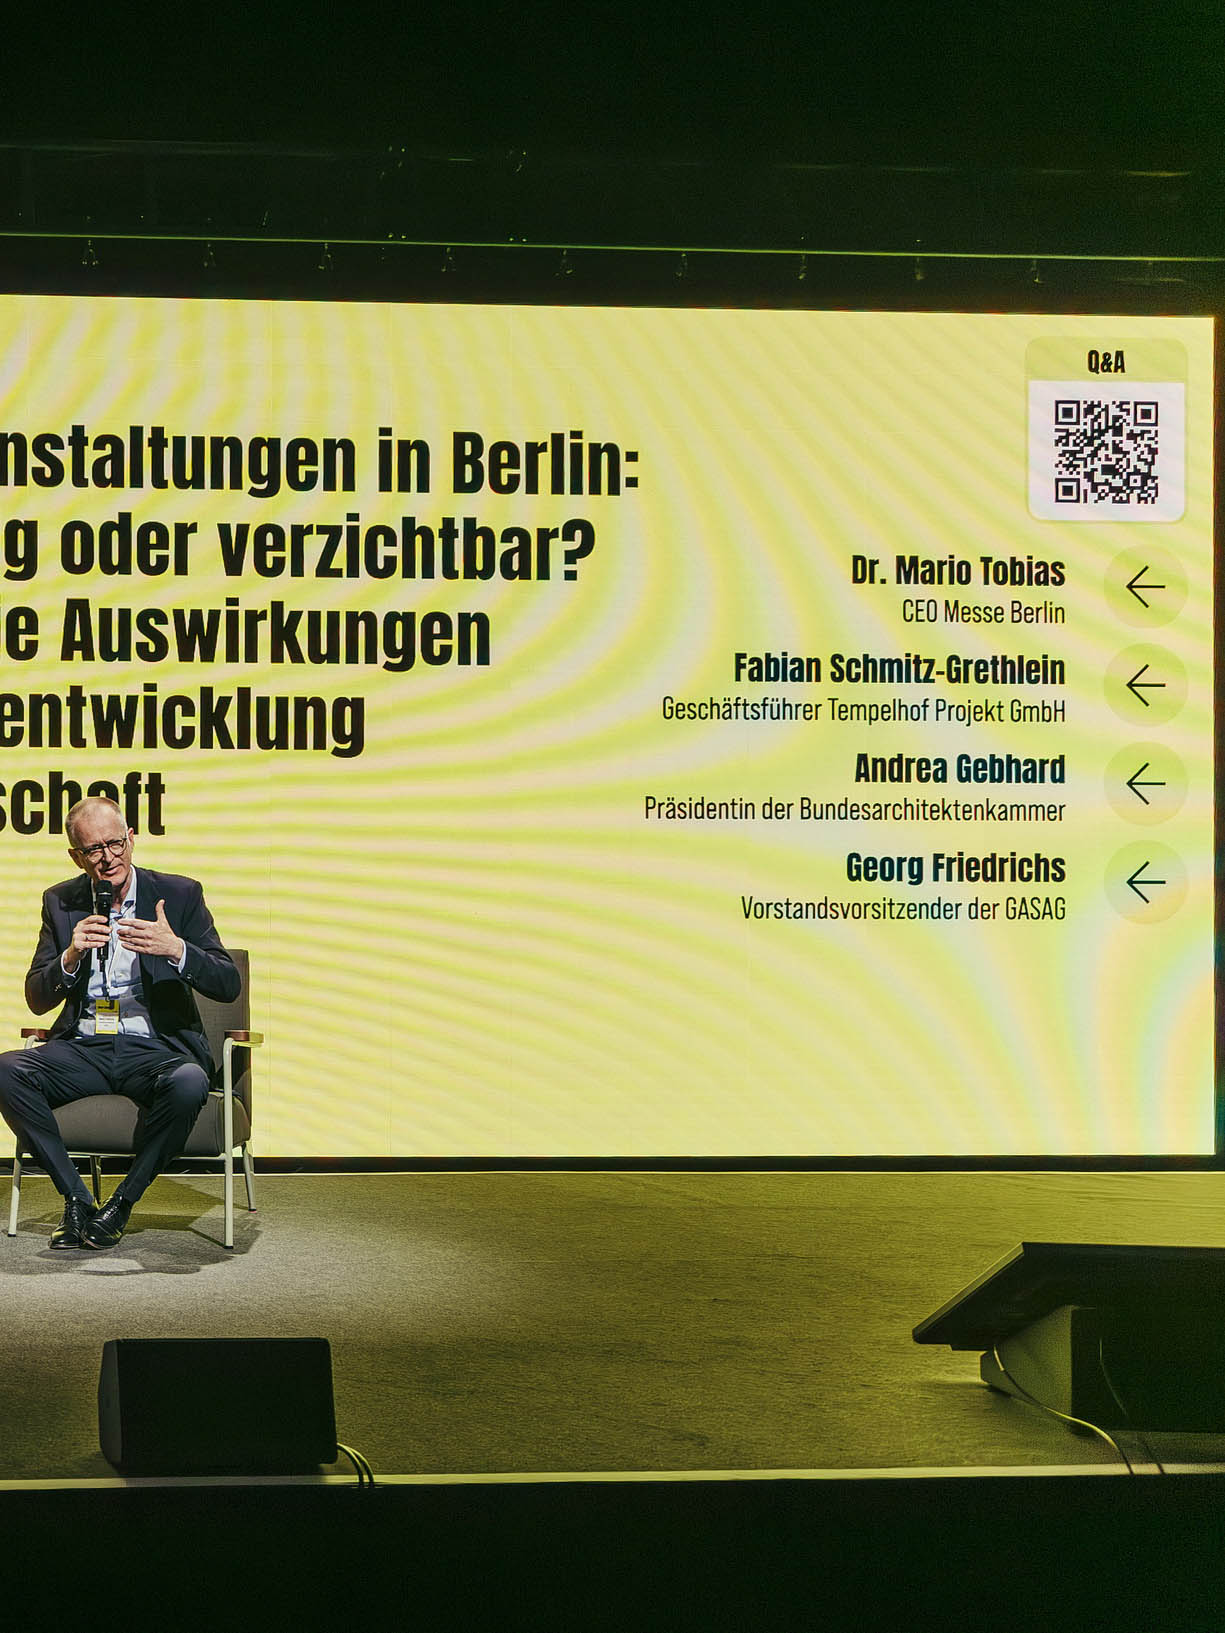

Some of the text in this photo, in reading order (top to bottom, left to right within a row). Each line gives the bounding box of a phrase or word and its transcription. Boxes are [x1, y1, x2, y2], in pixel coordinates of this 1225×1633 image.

[1088, 350, 1125, 374] Q&A
[379, 427, 430, 493] in
[453, 431, 638, 496] Berlin:
[61, 512, 197, 576] oder
[217, 513, 595, 580] verzichtbar?
[853, 555, 1065, 586] Dr. Mario Tobias
[903, 599, 1064, 623] CEO Messe Berlin
[61, 598, 489, 672] Auswirkungen
[735, 652, 1064, 684] Fabian Schmitz-Grethlein
[663, 696, 1064, 726] Geschäftsführer Tempelhof Projekt GmbH
[855, 754, 1065, 783] Andrea Gebhard
[646, 796, 1065, 821] Präsidentin der Bundesarchitektenkammer
[847, 852, 1065, 885] Georg Friedrichs
[742, 896, 1065, 919] Vorstandsvorsitzender der GASAG
